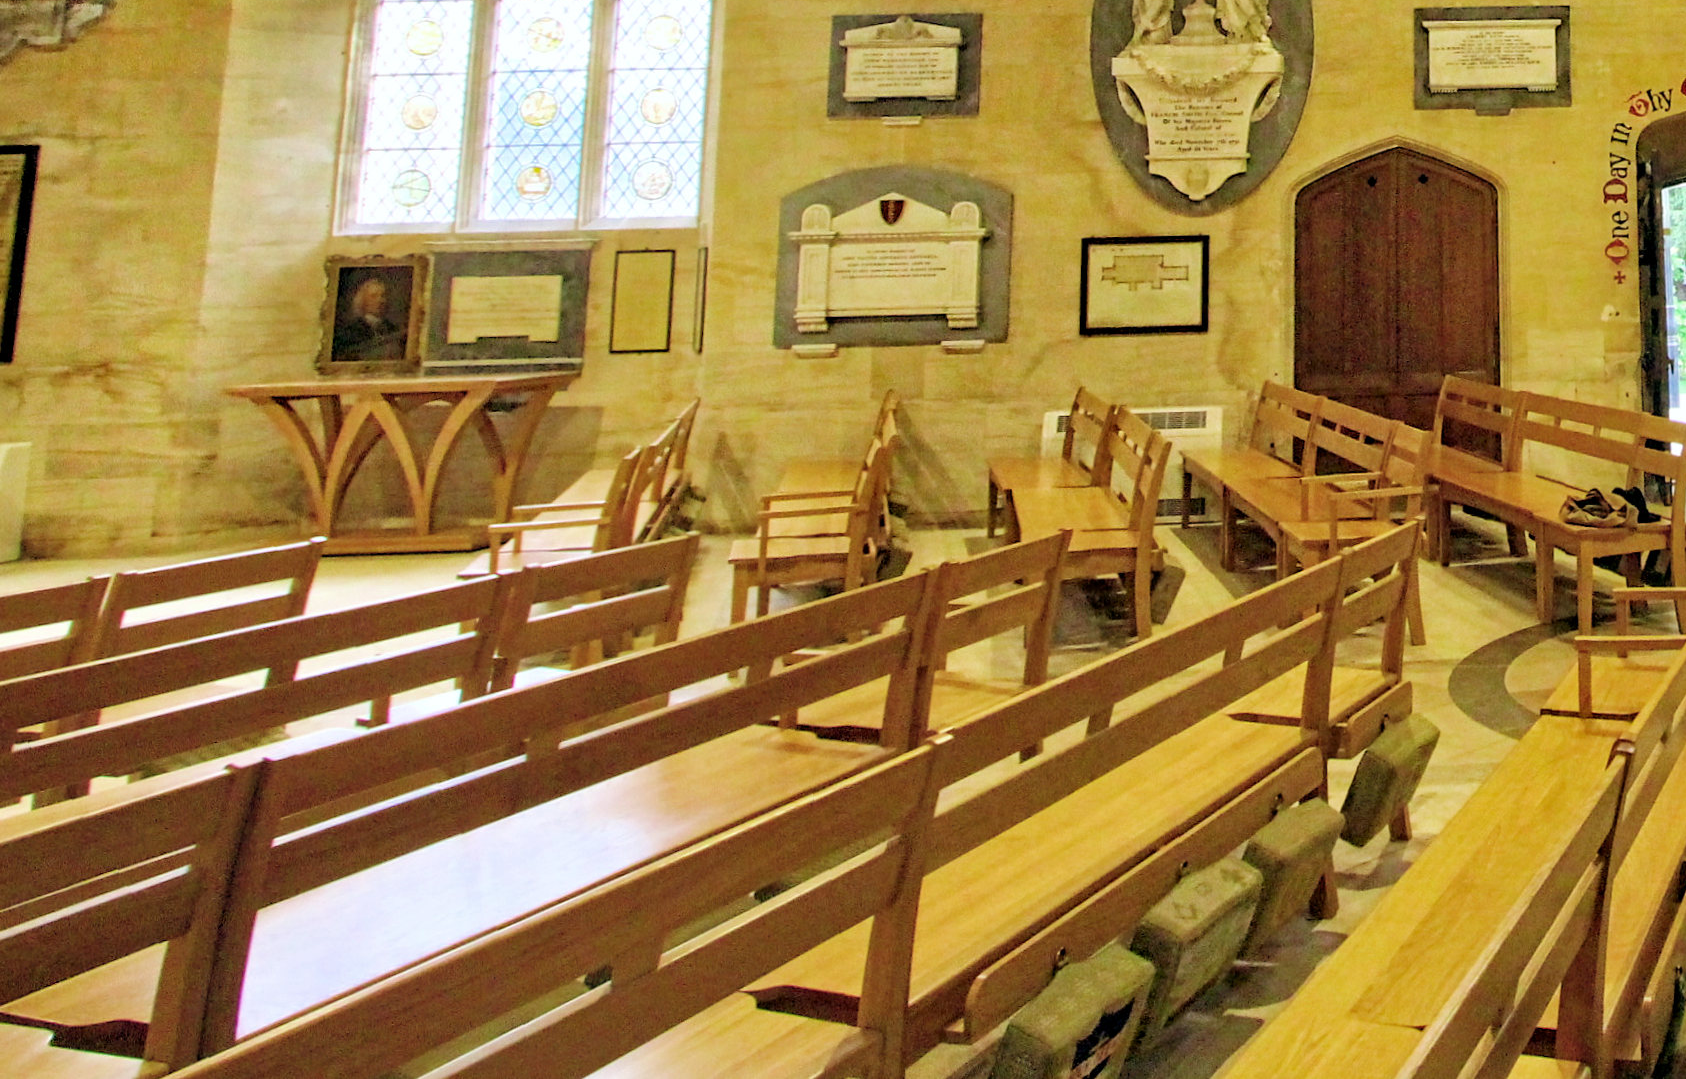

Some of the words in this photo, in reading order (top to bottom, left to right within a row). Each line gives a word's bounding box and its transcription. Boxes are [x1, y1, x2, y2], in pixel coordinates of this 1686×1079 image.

[1624, 89, 1674, 118] Thy
[1602, 152, 1632, 205] Day
[1604, 210, 1630, 266] One
